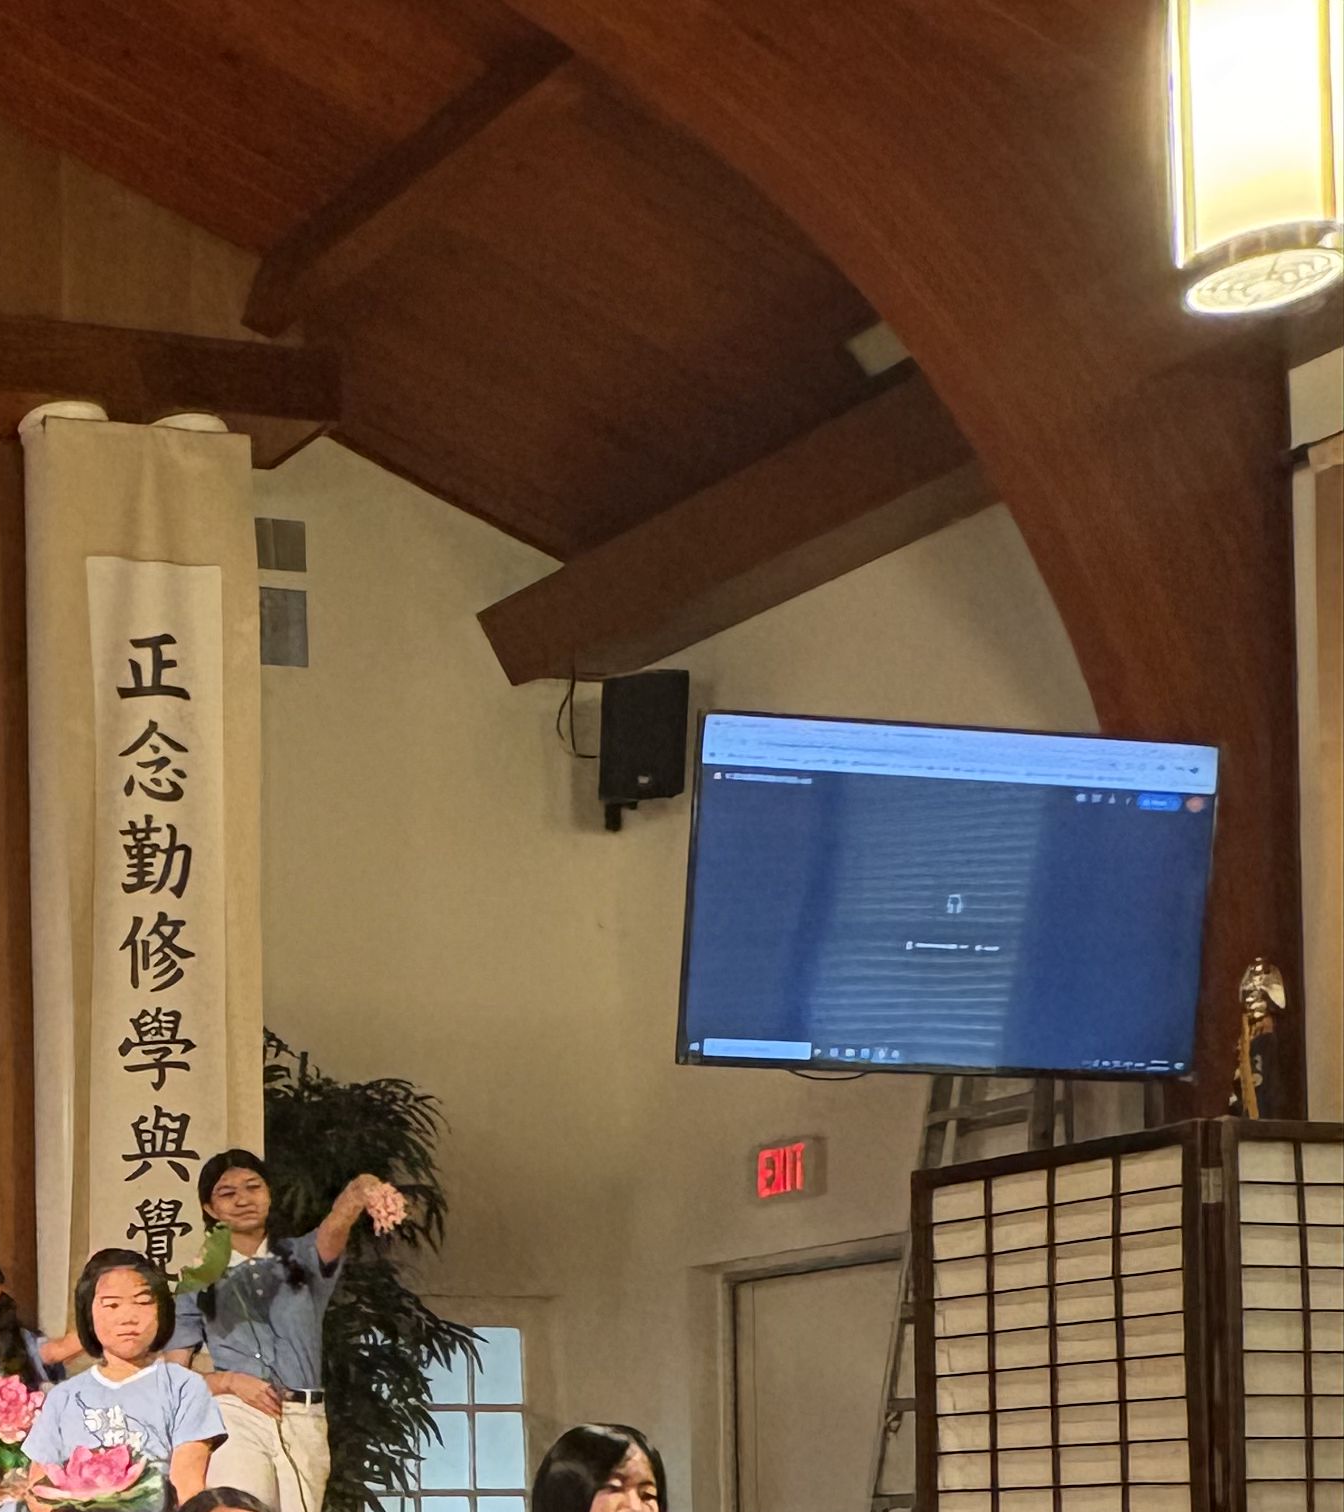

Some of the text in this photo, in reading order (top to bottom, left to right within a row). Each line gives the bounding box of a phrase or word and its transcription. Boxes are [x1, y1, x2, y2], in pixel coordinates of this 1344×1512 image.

[116, 632, 202, 1283] 正念勤修學與覺
[758, 1142, 806, 1199] EXIT
